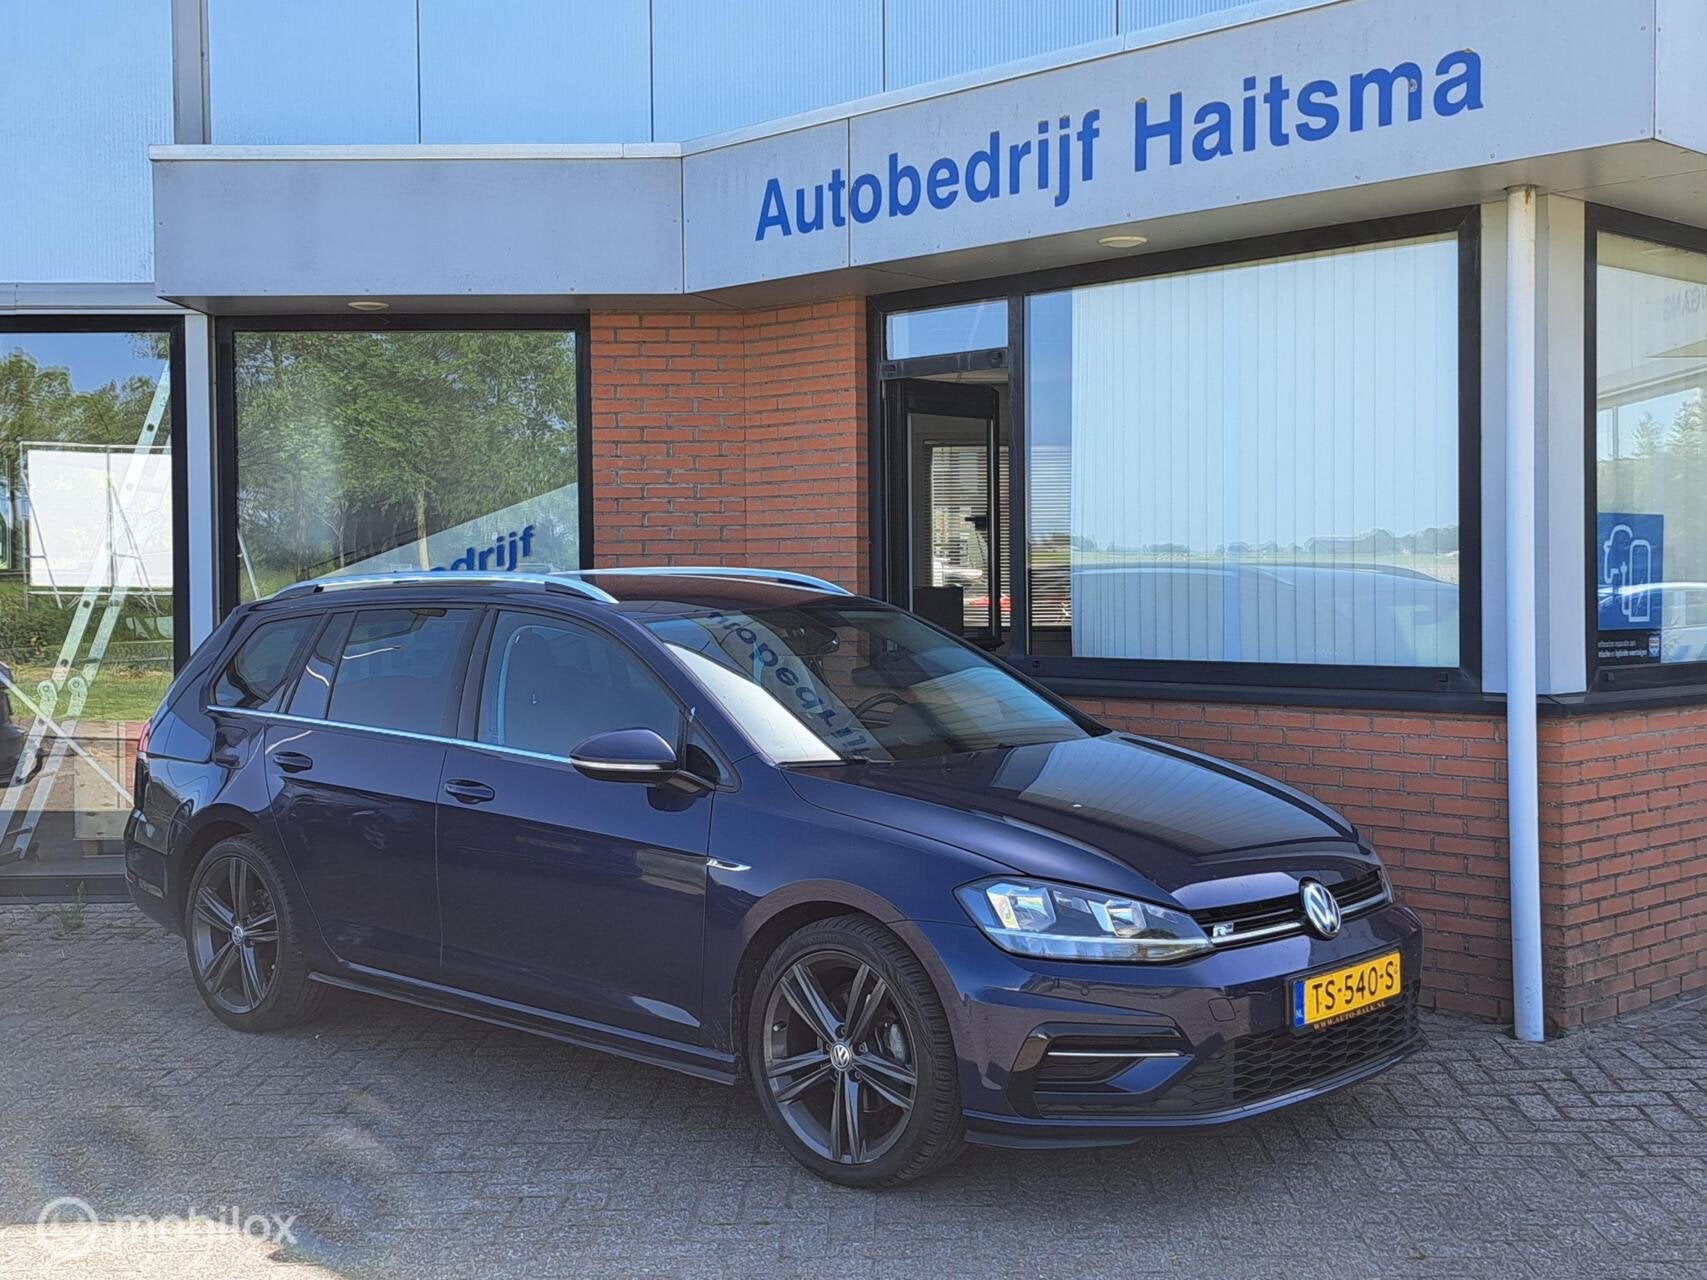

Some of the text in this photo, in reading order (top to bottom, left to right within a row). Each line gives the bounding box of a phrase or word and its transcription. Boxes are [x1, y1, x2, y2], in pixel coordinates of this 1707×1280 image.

[755, 48, 1484, 242] Autobedrijf Haitsma
[430, 525, 535, 571] drijf
[1312, 961, 1394, 1014] TS-540-S
